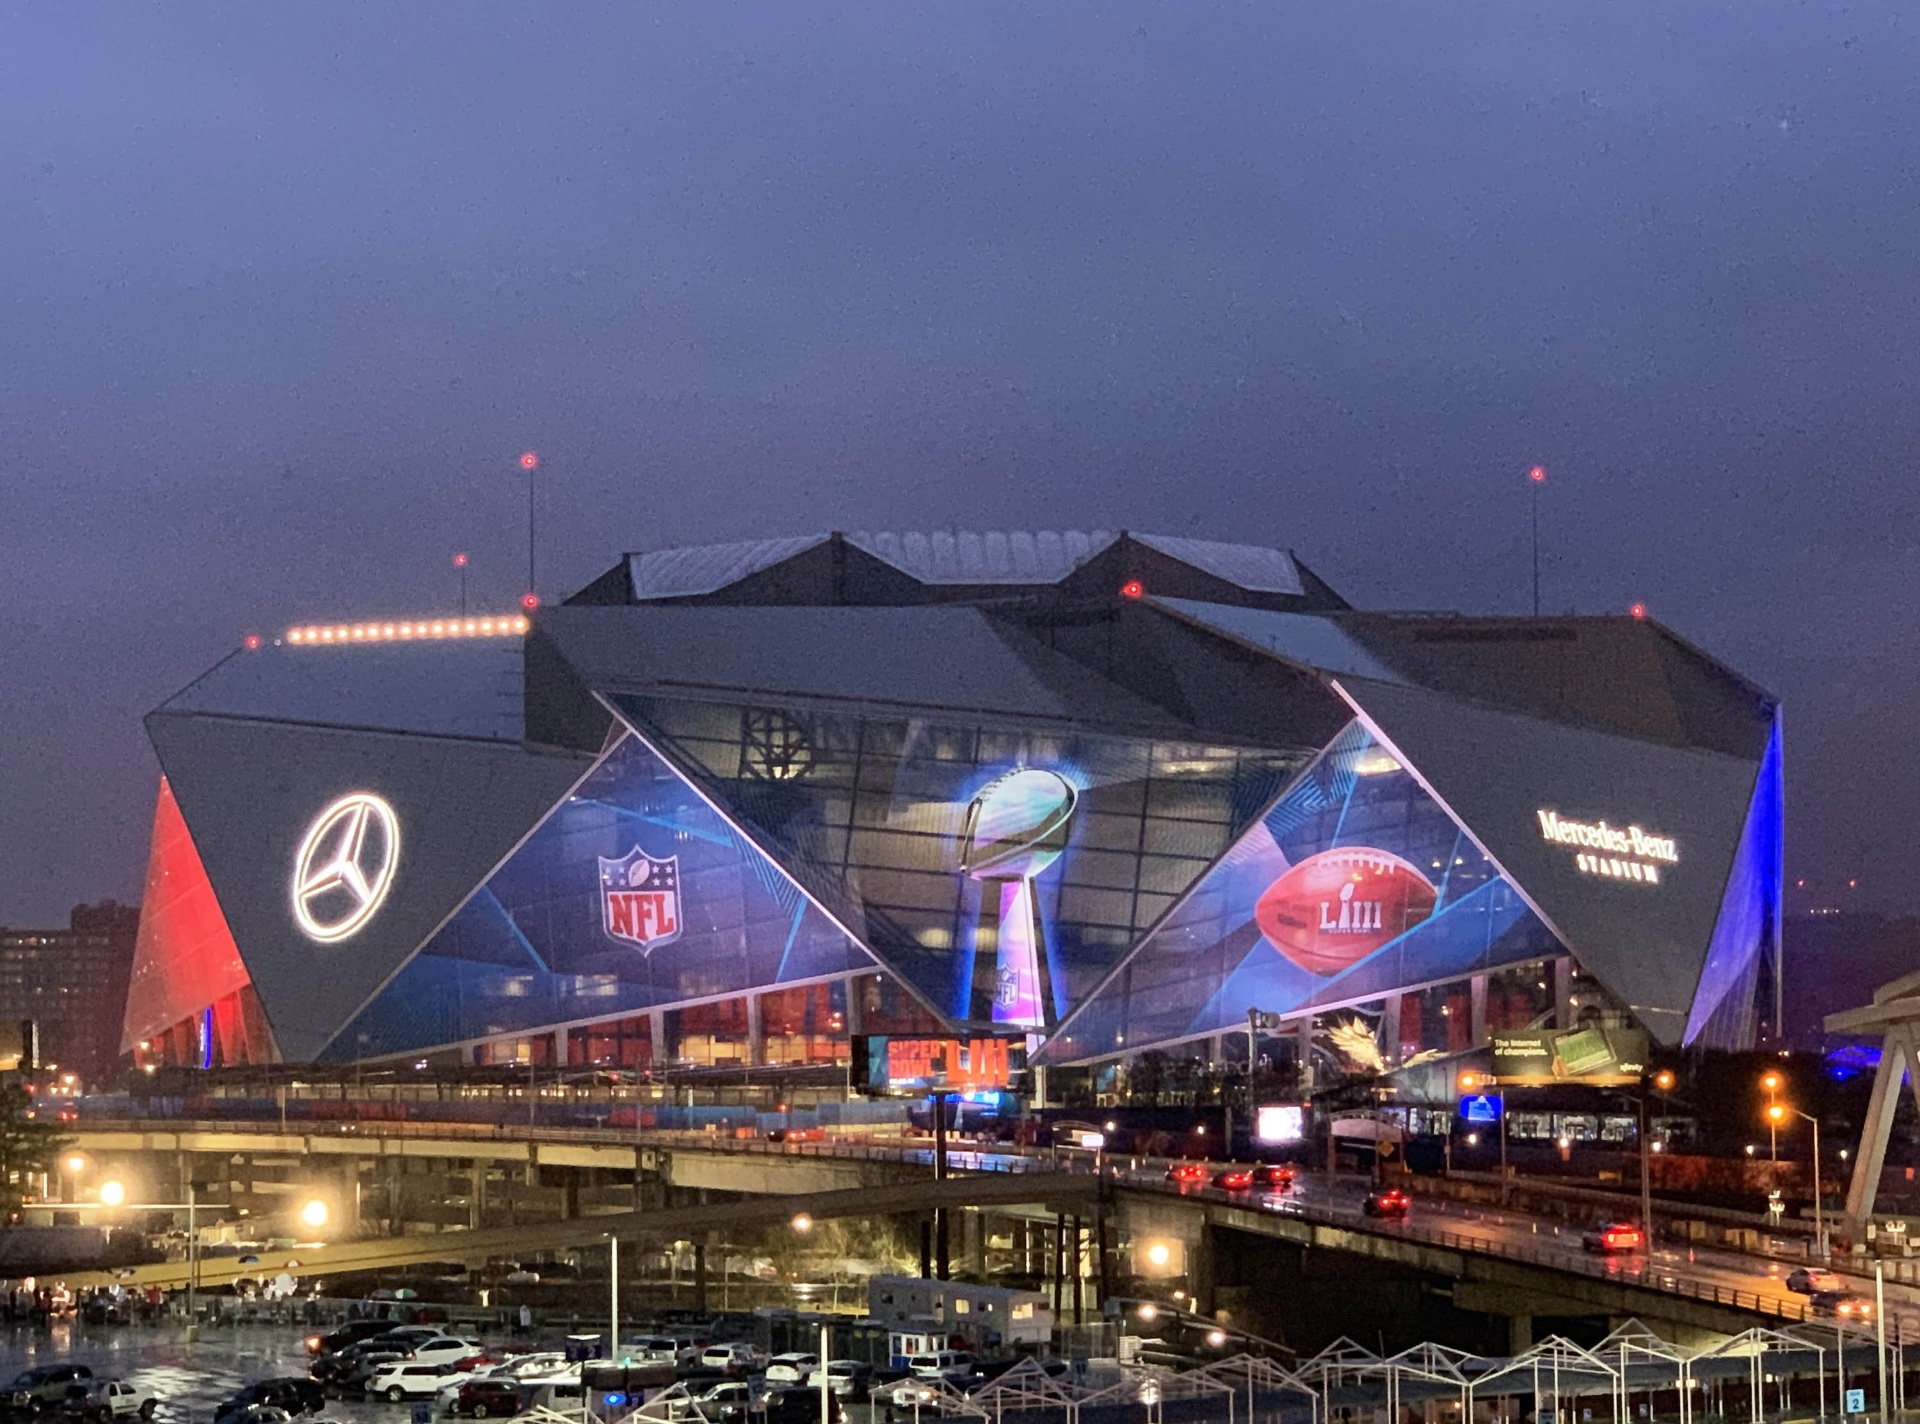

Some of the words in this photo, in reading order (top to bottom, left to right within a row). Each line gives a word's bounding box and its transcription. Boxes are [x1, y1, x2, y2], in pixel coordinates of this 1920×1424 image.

[1537, 810, 1678, 861] Mercedes-Benz
[1577, 853, 1658, 884] STADIUM
[609, 893, 674, 942] NFL
[888, 1040, 941, 1059] SUPER
[1495, 1039, 1509, 1047] The
[1510, 1039, 1541, 1047] Internet
[1504, 1048, 1548, 1056] champions.
[888, 1059, 935, 1077] BOWL
[1620, 1063, 1643, 1072] xfinity
[1852, 1398, 1860, 1409] 2
